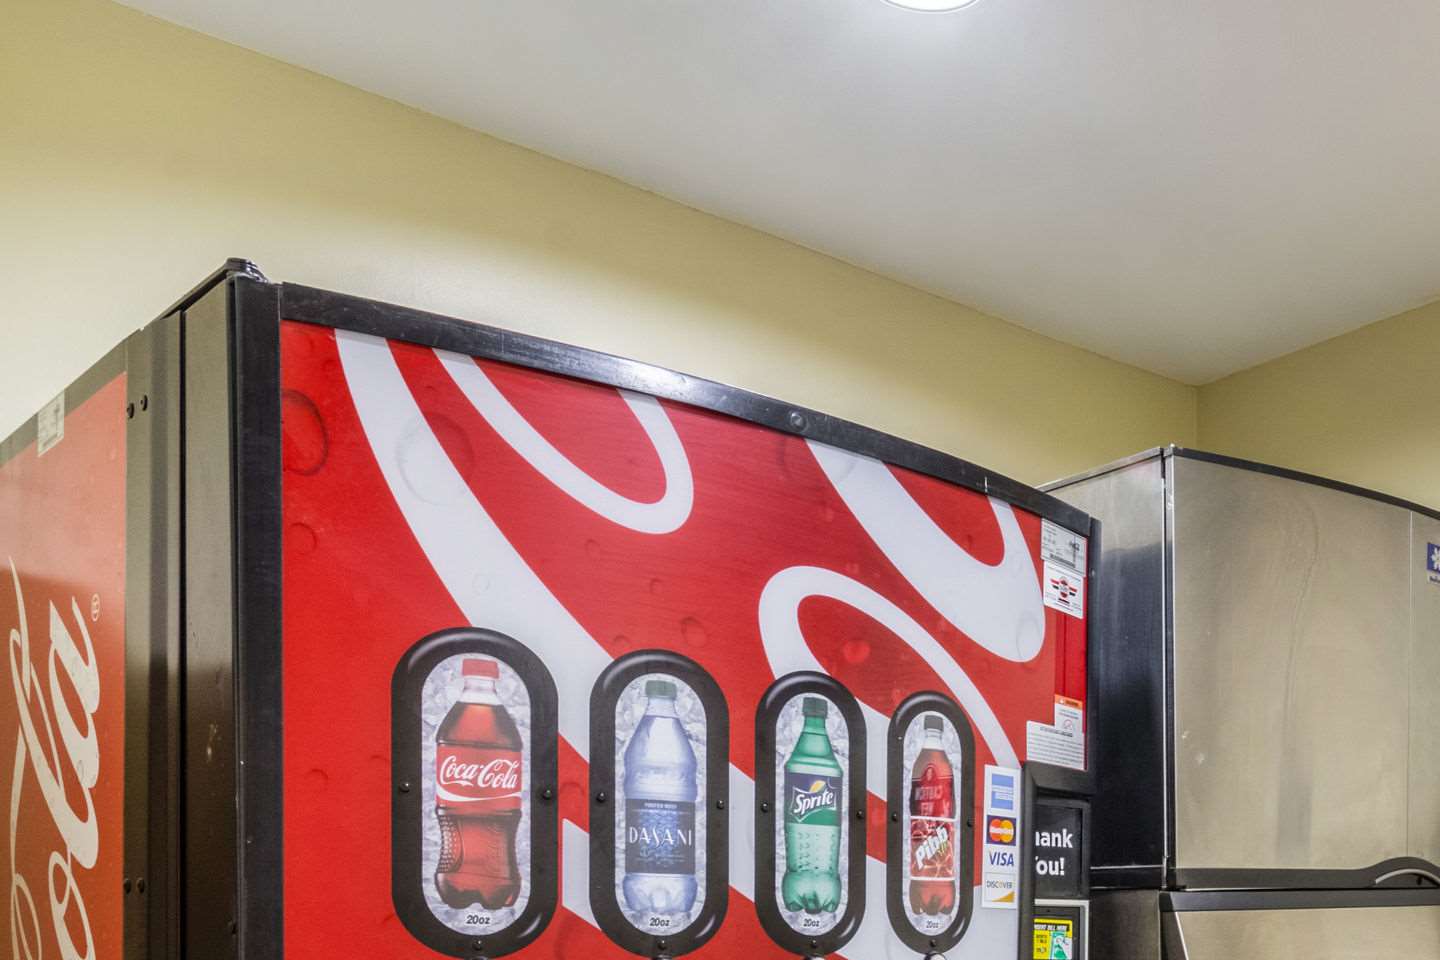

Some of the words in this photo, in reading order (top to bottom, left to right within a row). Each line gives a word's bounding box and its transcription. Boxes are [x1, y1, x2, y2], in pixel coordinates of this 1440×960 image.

[439, 755, 520, 789] Coca-Cola
[793, 786, 833, 815] Sprite
[629, 826, 692, 847] DASANI
[1035, 828, 1074, 848] ank
[989, 851, 1014, 867] VISA
[1035, 856, 1065, 876] ou!
[986, 880, 1013, 889] DISCOVER
[466, 914, 490, 925] 20oz
[649, 917, 670, 927] 20oz
[803, 918, 820, 927] 20oz
